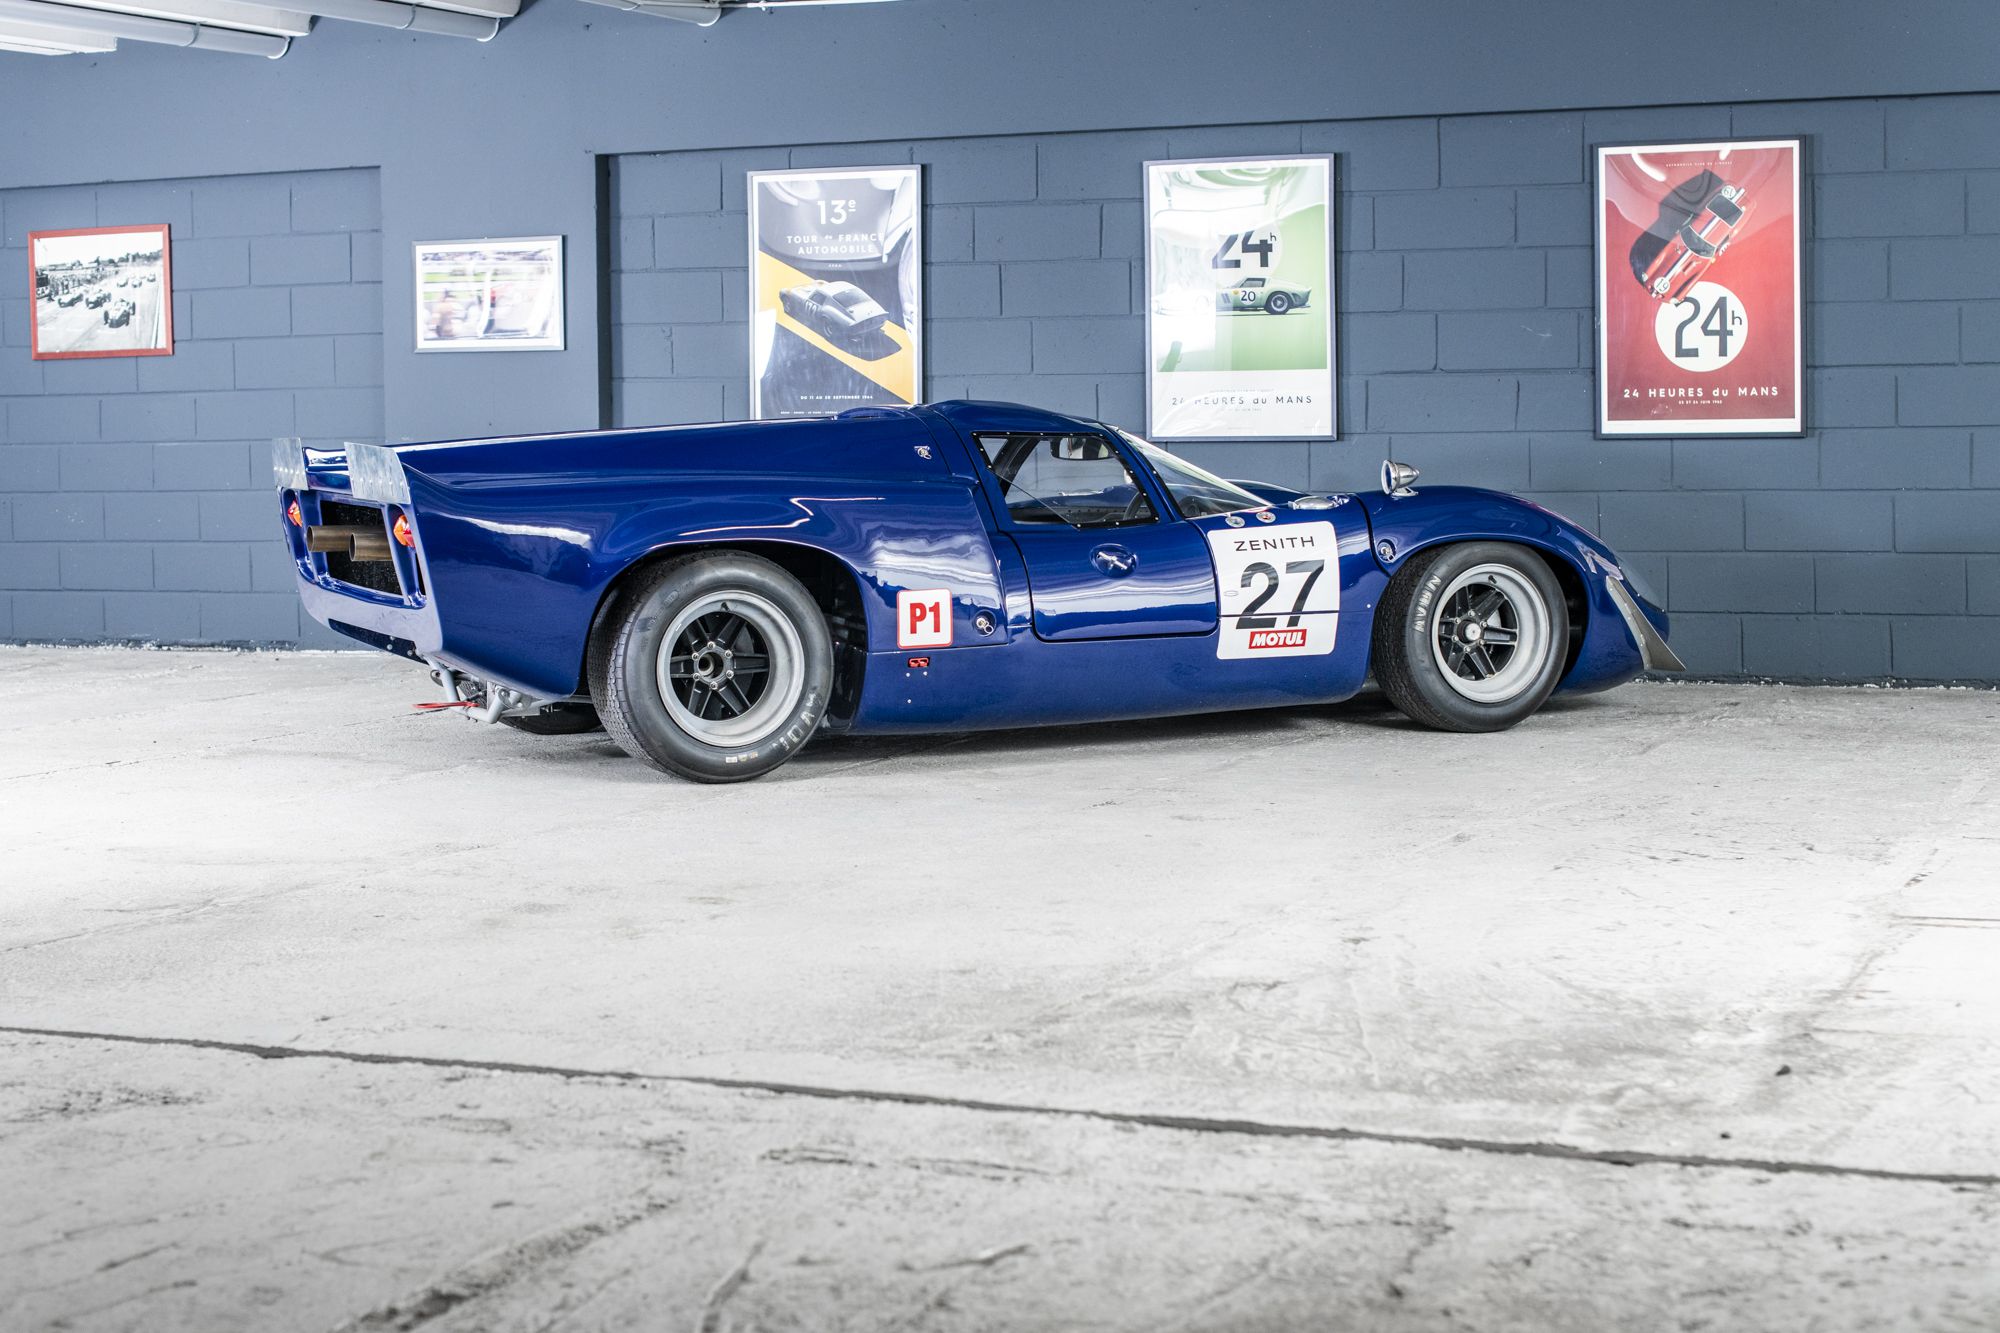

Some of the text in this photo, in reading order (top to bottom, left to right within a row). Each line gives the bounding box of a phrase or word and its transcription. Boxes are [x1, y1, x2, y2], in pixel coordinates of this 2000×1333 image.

[786, 235, 817, 244] TOUR
[798, 244, 875, 255] AUTOMOBILE
[1240, 290, 1256, 302] 20
[1623, 386, 1779, 398] 24 HEURES du MANS
[1252, 396, 1267, 404] du
[1275, 395, 1313, 404] MANS
[1233, 535, 1315, 552] ZENITH
[1235, 559, 1326, 630] 27
[909, 601, 941, 635] P1
[1251, 631, 1305, 647] MOTUL
